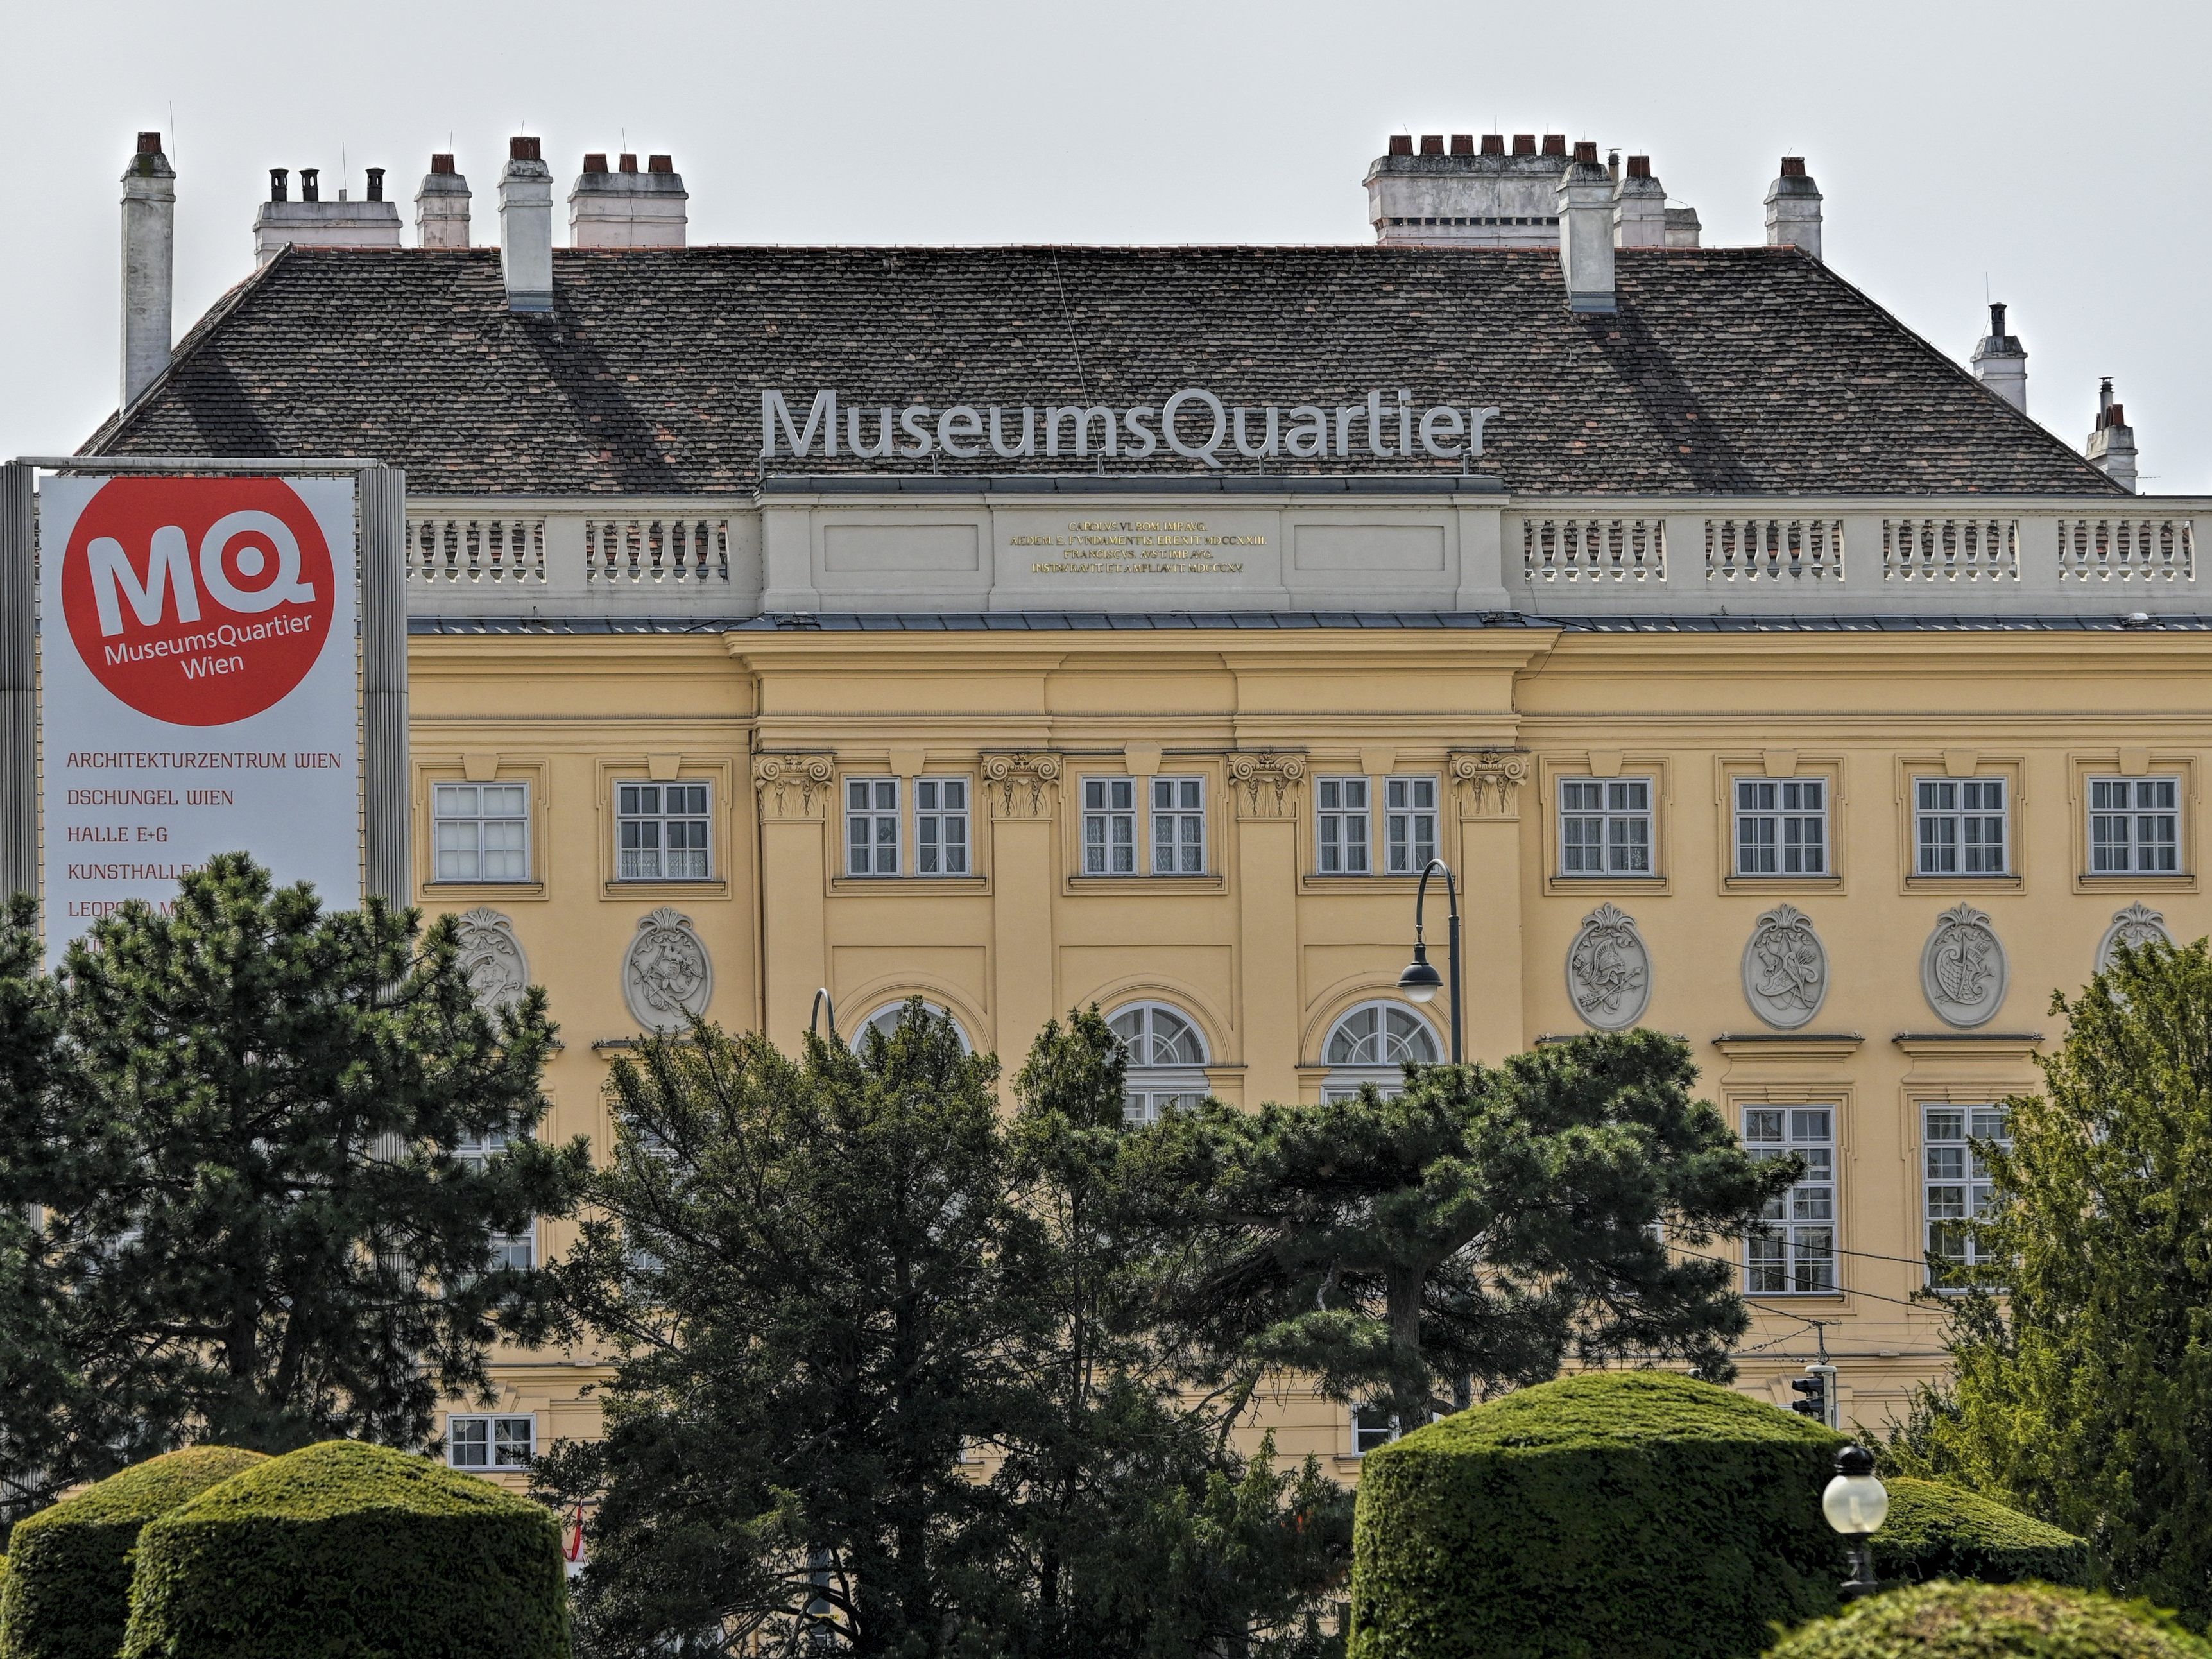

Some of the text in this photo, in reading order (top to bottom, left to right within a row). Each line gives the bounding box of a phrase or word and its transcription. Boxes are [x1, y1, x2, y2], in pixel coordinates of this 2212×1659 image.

[761, 388, 1500, 469] MuseumsQuartier
[87, 510, 316, 637] MQ
[104, 615, 313, 666] MuseumsQuartier
[180, 653, 244, 680] Wien
[67, 752, 341, 768] ARCHITEKTURZENTRUM WIEN
[67, 790, 234, 805] DSCHUNGEL WIEN
[67, 827, 168, 842] HALLE E+G
